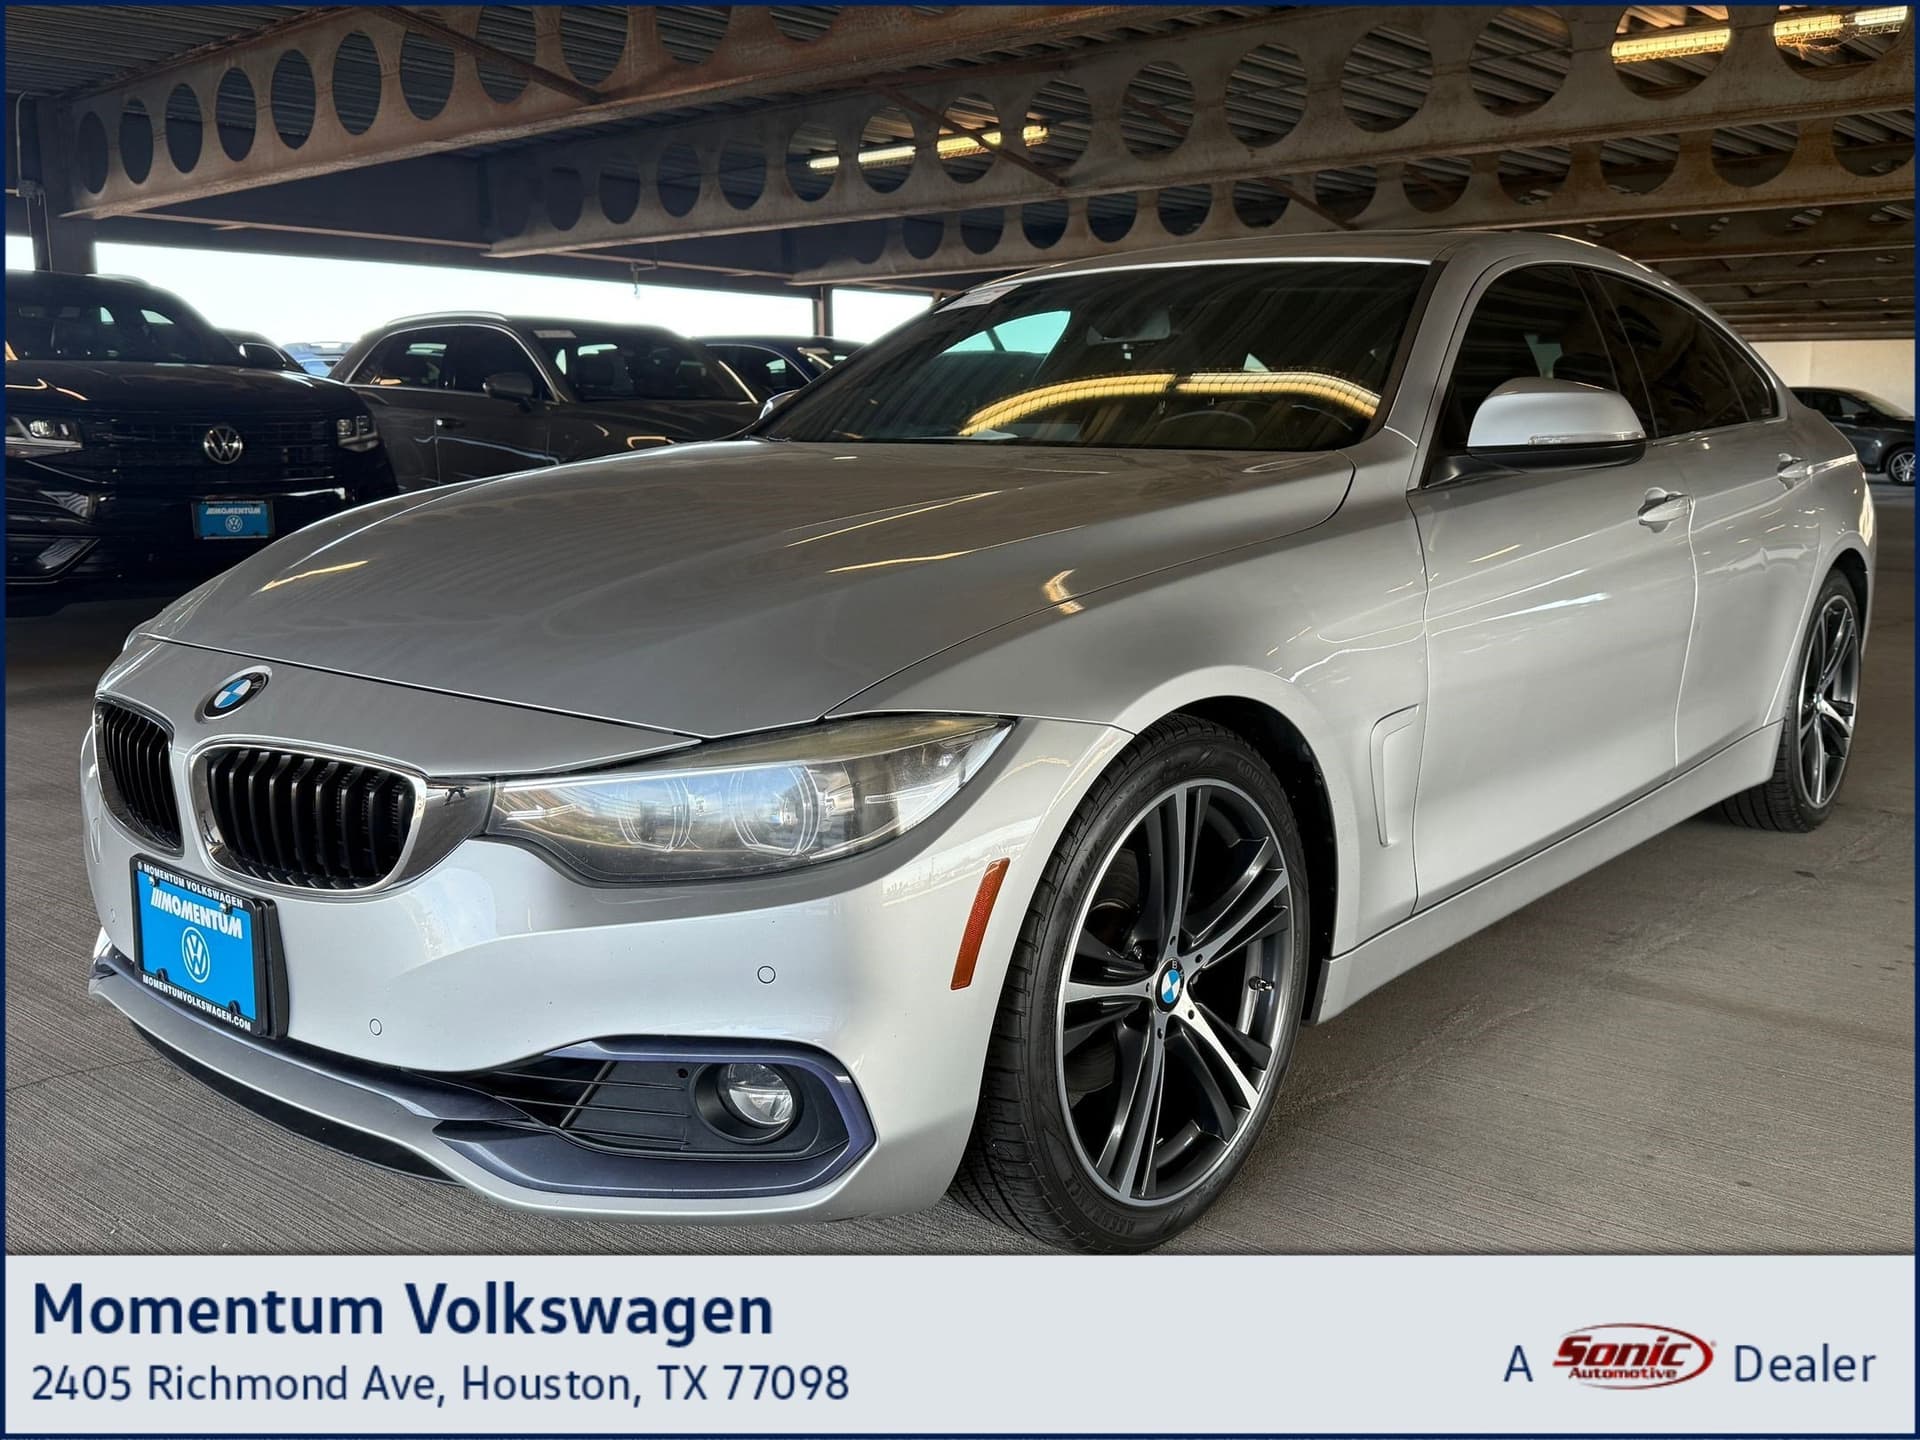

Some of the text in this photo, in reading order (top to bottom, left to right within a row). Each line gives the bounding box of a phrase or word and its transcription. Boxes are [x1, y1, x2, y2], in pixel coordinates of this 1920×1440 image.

[144, 863, 243, 908] MOMENTUM VOLKSWAGEN
[158, 891, 243, 939] MOMENTUM
[142, 974, 251, 1031] MOMENTUMVOLKSWAGEN.COM
